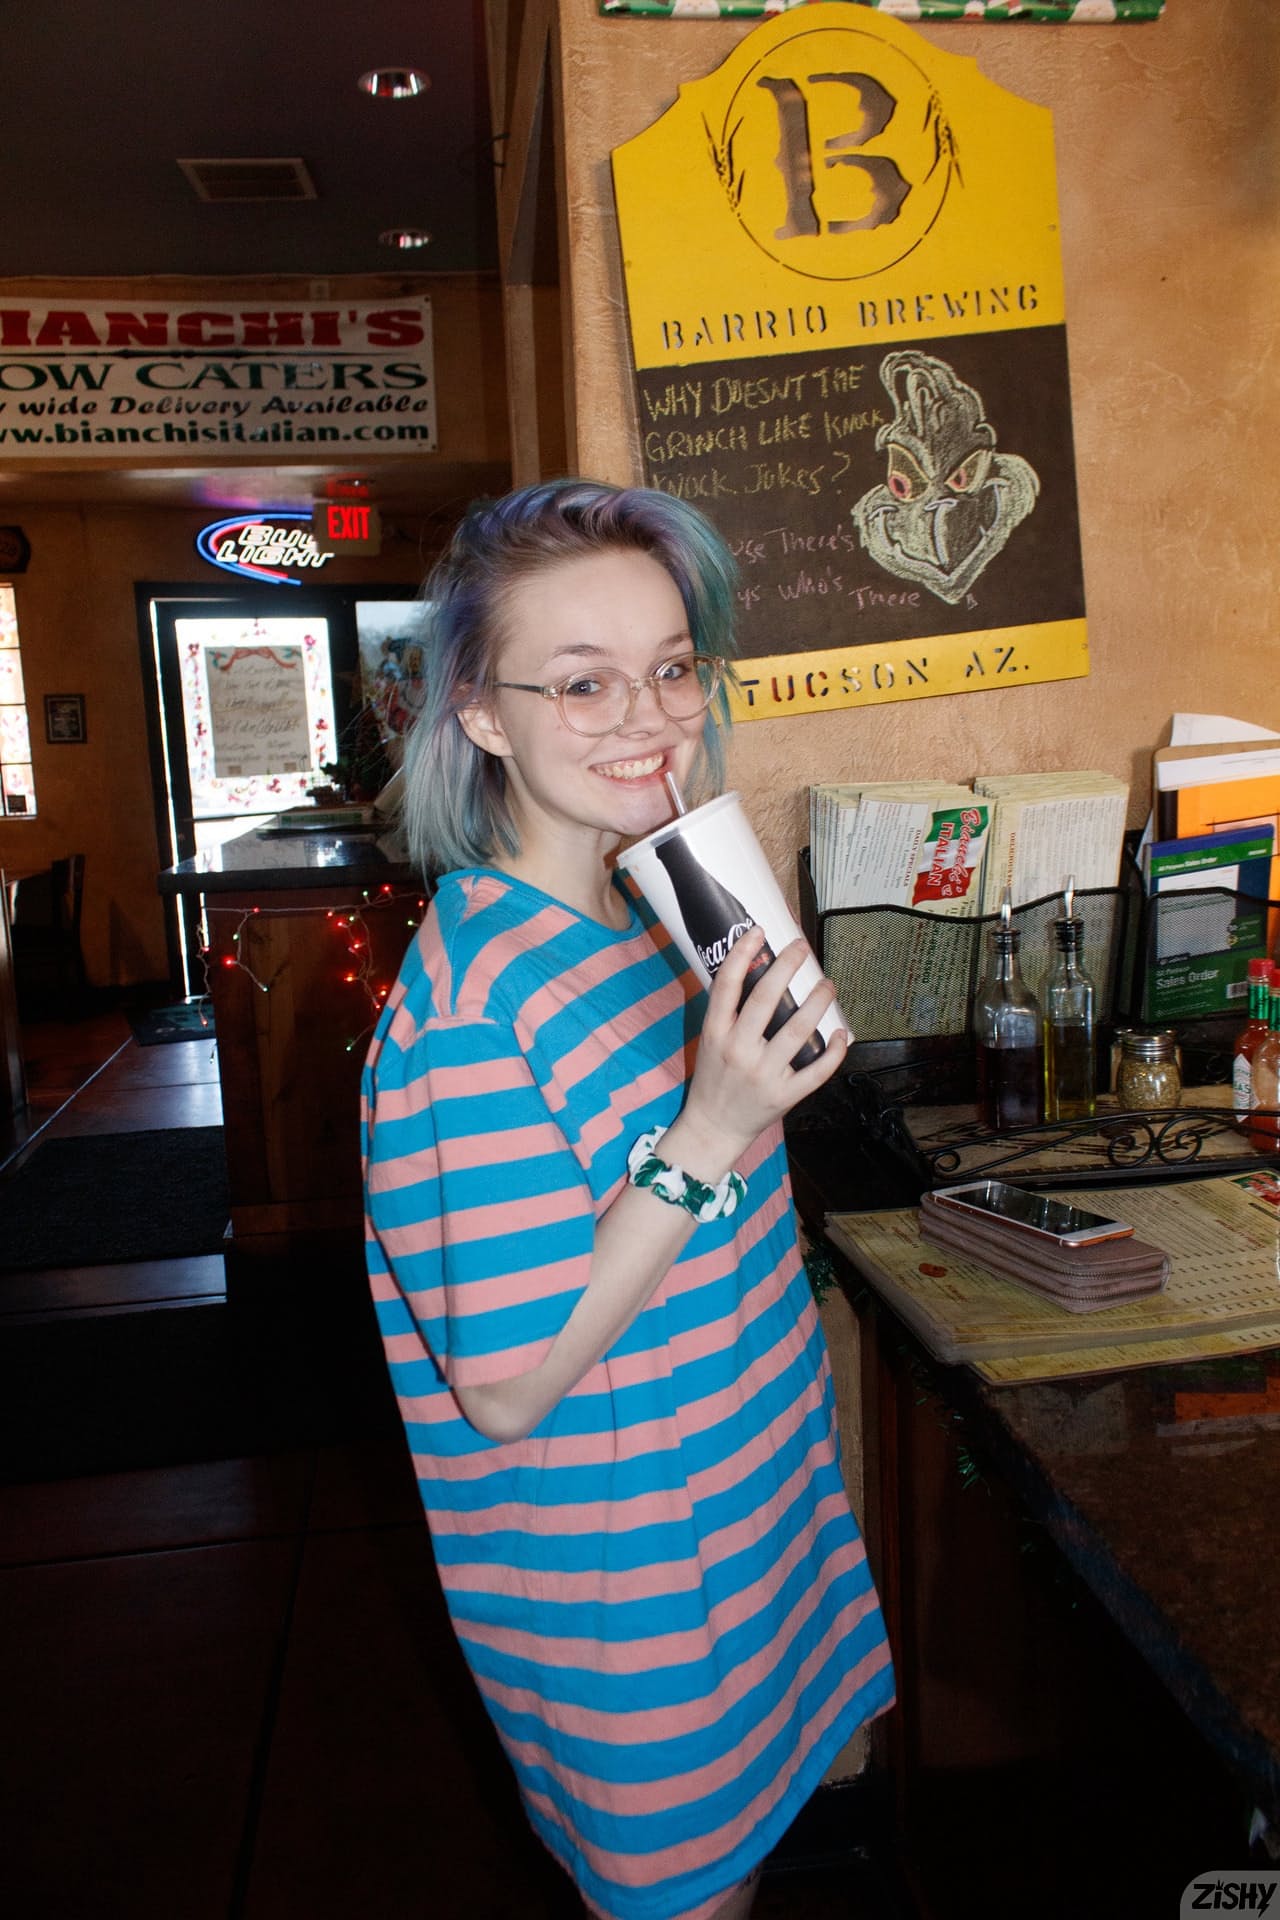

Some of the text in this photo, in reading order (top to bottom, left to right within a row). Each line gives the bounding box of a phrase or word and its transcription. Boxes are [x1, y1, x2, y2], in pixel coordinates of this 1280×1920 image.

[757, 72, 912, 240] B
[0, 308, 425, 348] IANCHI'S
[662, 284, 1039, 350] BARRIO BREWING
[0, 361, 429, 392] OW CATERS
[643, 380, 703, 422] WHY
[812, 364, 866, 398] THE
[18, 397, 98, 417] wide
[110, 395, 251, 419] Delivery
[260, 393, 429, 416] Available
[0, 420, 430, 444] w.bianchisitalian.com
[644, 425, 749, 464] GRINCH
[758, 411, 812, 446] LIKE
[327, 506, 371, 540] EXIT
[849, 585, 921, 610] There
[739, 646, 1030, 707] TUCSON AZ.
[926, 822, 956, 887] ITALIAN
